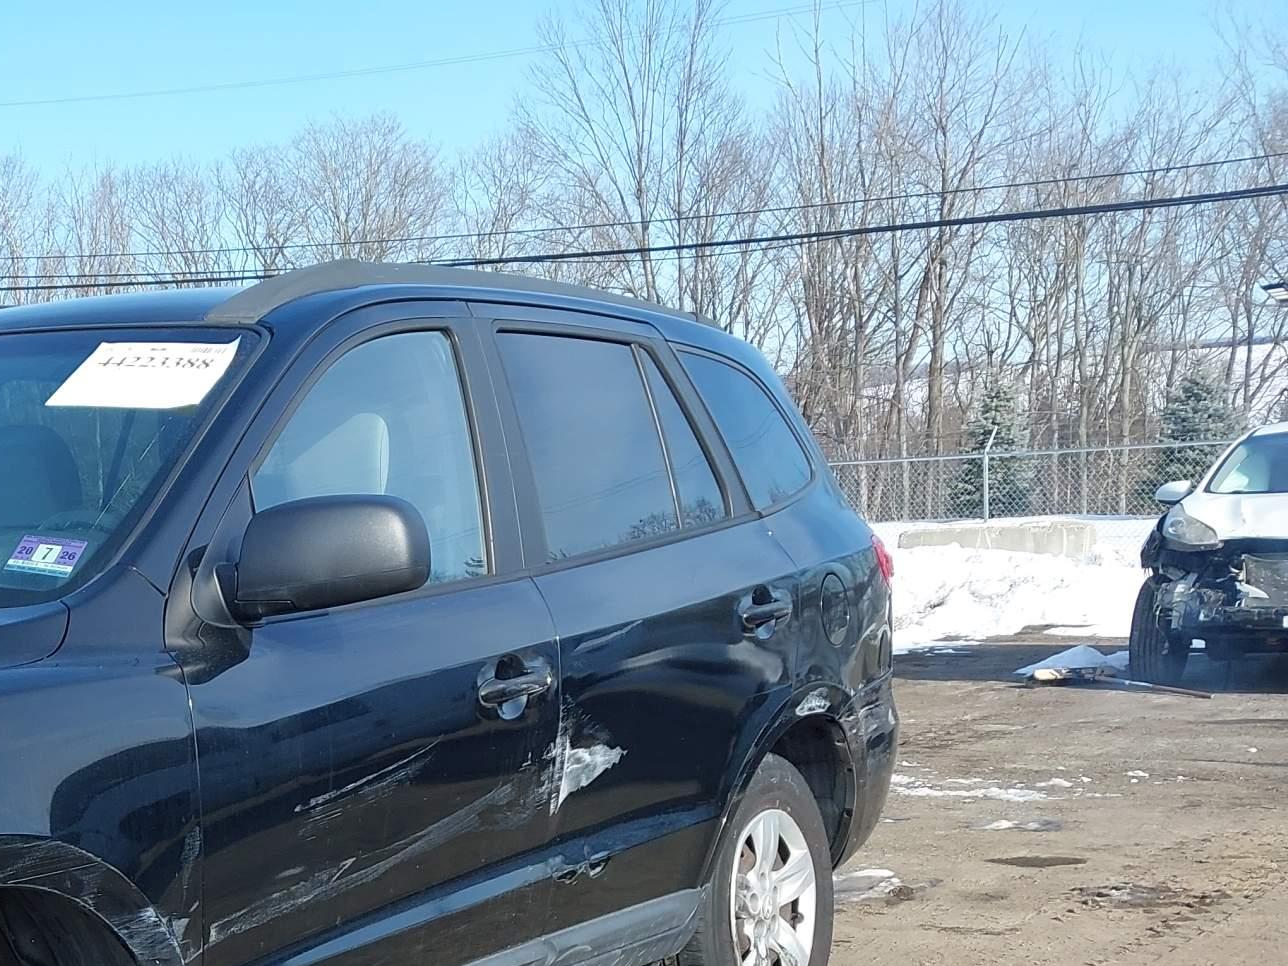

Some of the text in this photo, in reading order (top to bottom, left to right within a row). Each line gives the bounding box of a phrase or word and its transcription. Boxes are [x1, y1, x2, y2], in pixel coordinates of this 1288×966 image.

[97, 356, 215, 370] 44223388
[16, 545, 77, 561] 20 7 26
